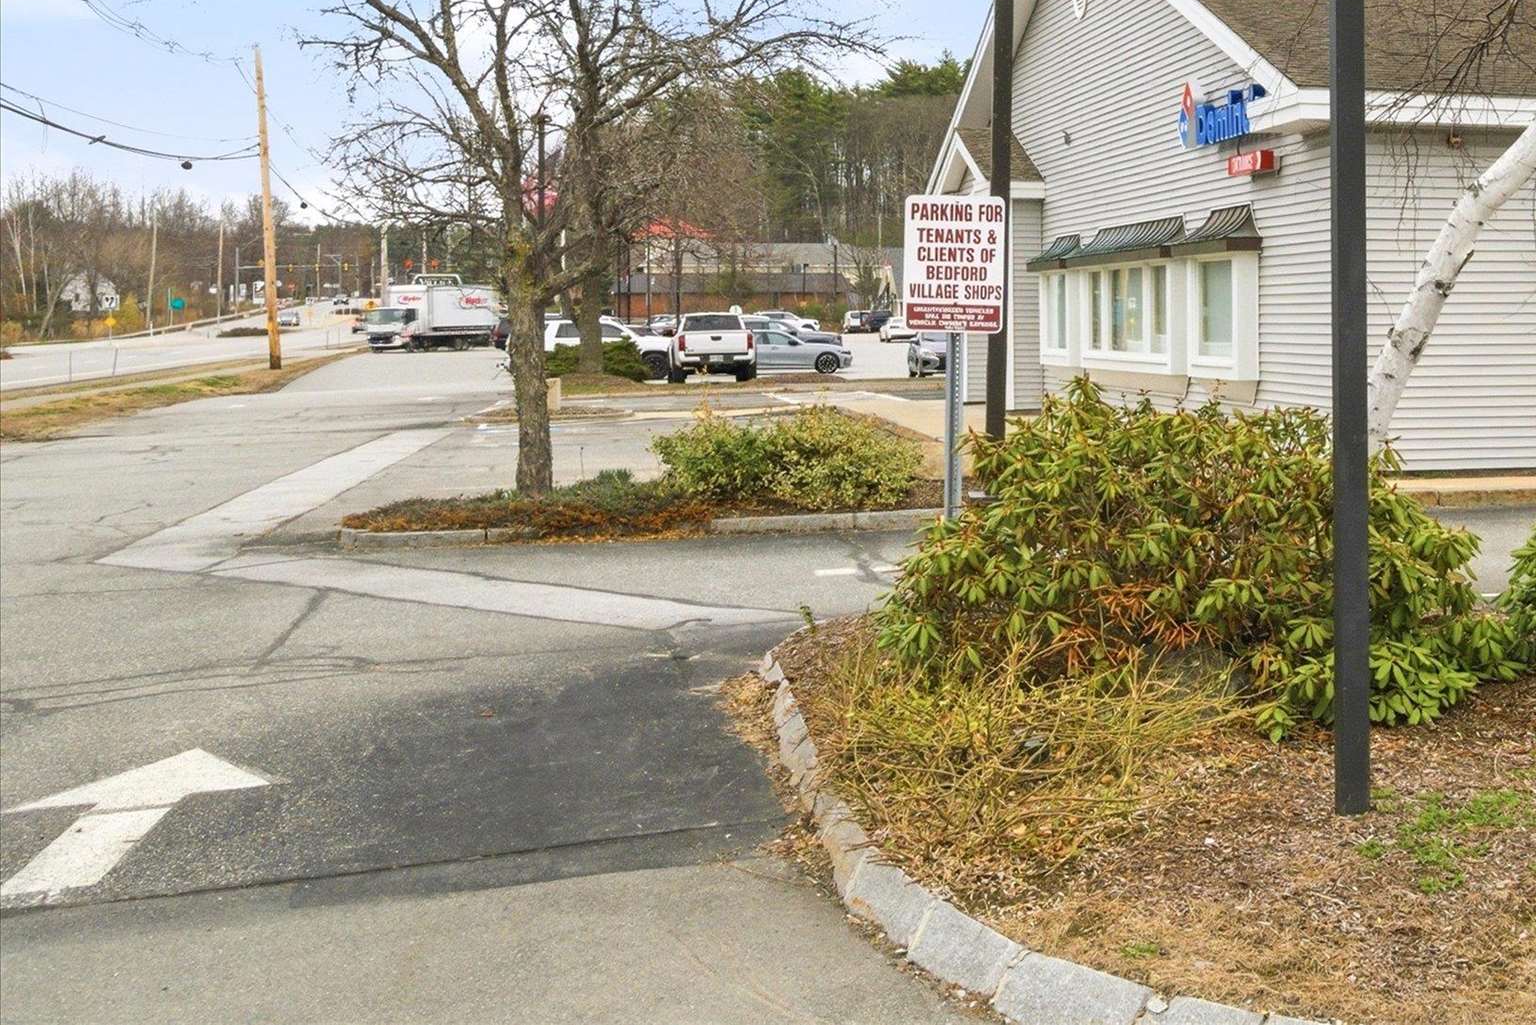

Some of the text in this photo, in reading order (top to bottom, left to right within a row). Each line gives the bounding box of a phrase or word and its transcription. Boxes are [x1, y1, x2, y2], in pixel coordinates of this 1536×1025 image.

[911, 202, 1003, 223] PARKING FOR
[916, 227, 998, 245] TENANTS &
[917, 246, 996, 264] CLIENTS OF
[926, 265, 988, 282] BEDFORD
[909, 283, 1003, 301] VILLAGE SHOPS
